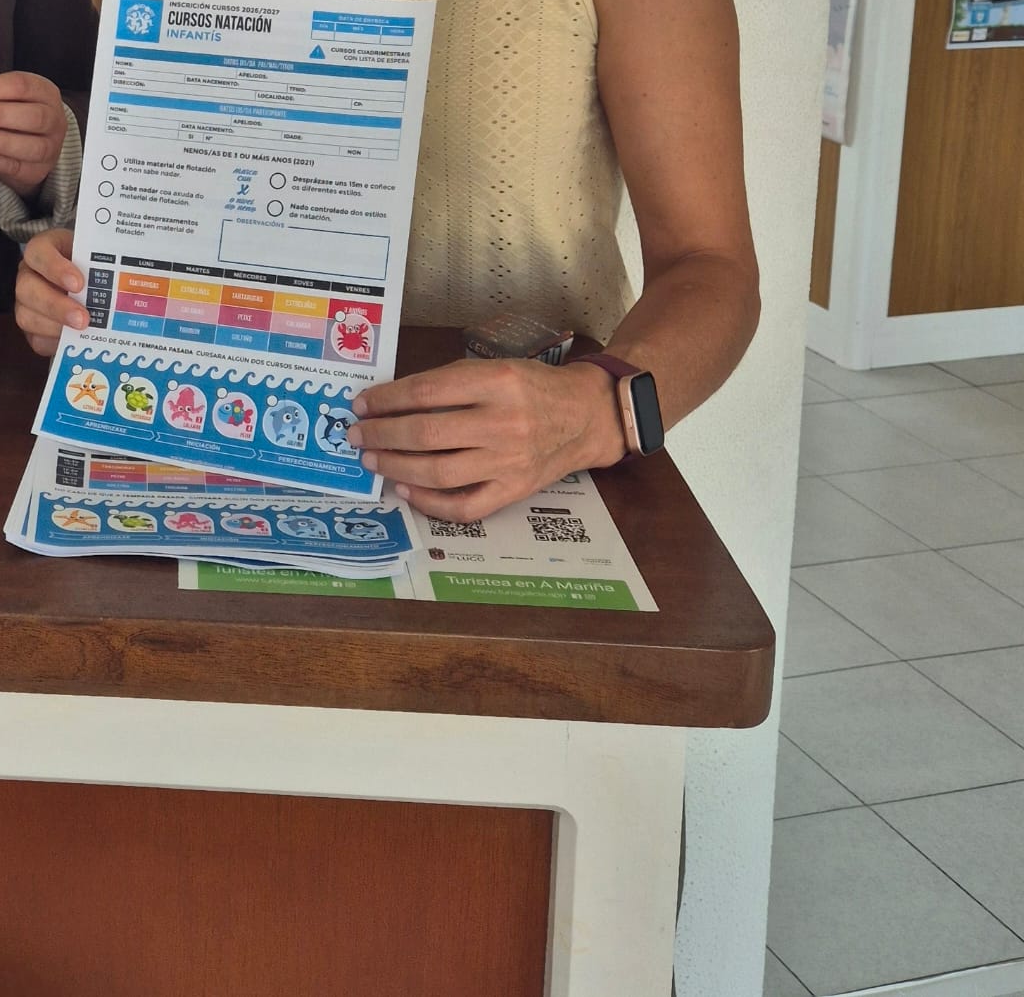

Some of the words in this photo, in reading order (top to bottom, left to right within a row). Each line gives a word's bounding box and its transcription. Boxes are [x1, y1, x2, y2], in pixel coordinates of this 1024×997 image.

[170, 2, 210, 10] INSCRICIÓN
[168, 11, 211, 27] CURSOS
[215, 15, 272, 32] NATACIÓN
[167, 28, 222, 42] INFANTÍS
[184, 147, 220, 156] NENOS/AS
[186, 165, 216, 173] flotación
[293, 176, 333, 186] Desprázase
[370, 183, 395, 191] coñece
[302, 185, 337, 194] diferentes
[120, 193, 147, 201] material
[311, 206, 348, 214] controlado
[118, 211, 141, 219] Realiza
[143, 214, 198, 226] desprazamentos
[116, 227, 144, 236] flotación
[157, 225, 184, 233] material
[186, 266, 210, 274] MARTES
[346, 286, 370, 294] VENRES
[138, 342, 167, 351] TEMPADA
[168, 346, 193, 355] PASADA
[266, 361, 292, 370] CURSOS
[350, 372, 368, 380] UNHA
[278, 456, 346, 473] PERFECCIONAMENTO
[444, 575, 511, 588] Turistea
[515, 579, 535, 588] en
[556, 581, 615, 593] Mariña
